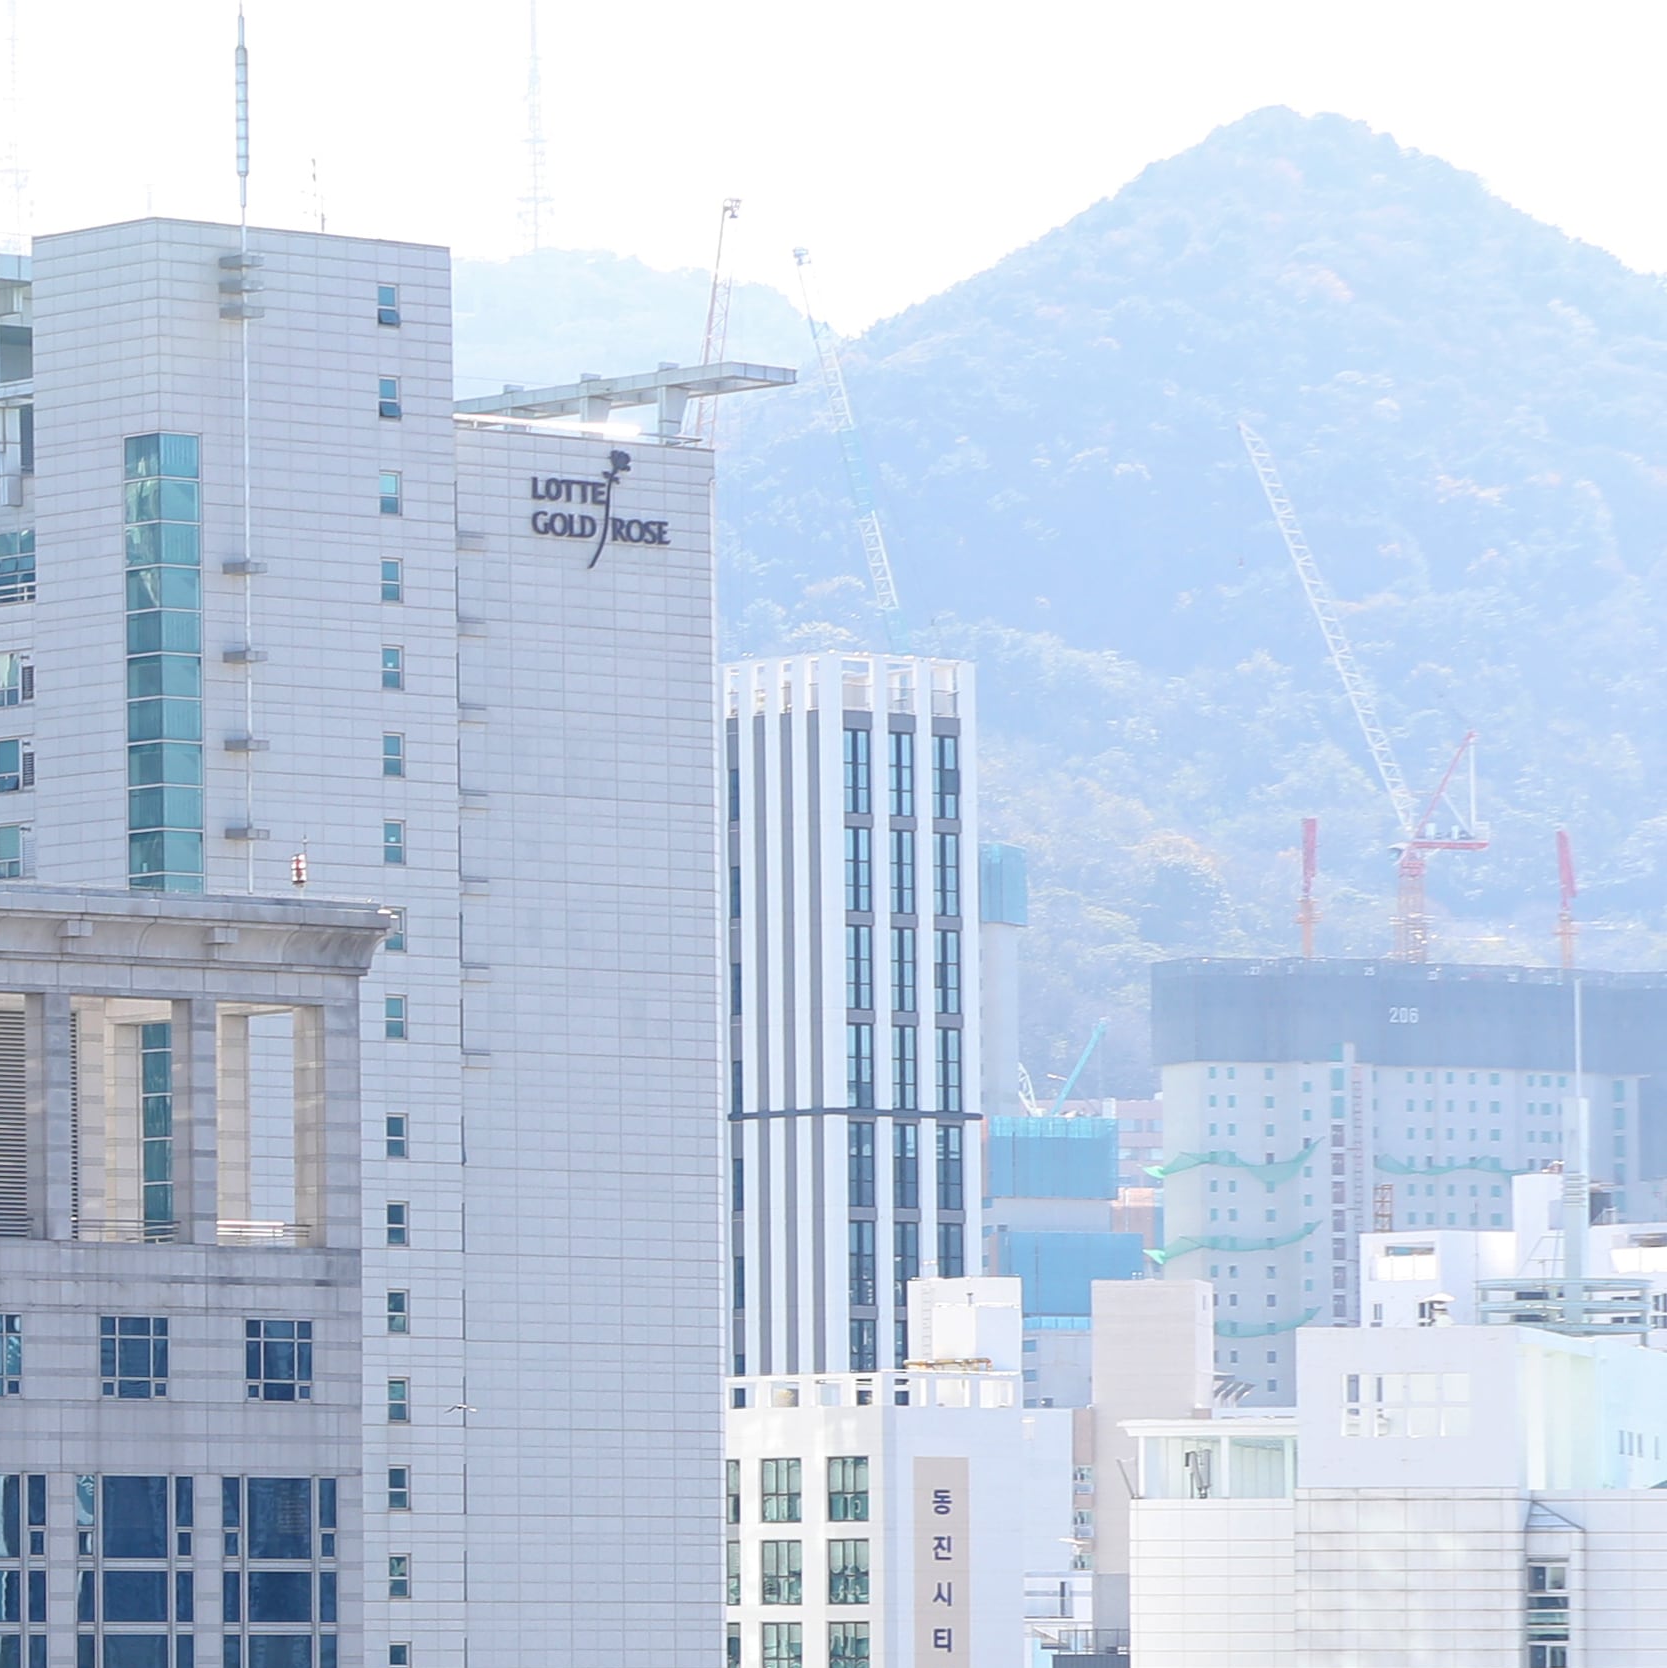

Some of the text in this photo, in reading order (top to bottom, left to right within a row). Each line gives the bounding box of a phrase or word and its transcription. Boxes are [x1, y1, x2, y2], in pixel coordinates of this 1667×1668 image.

[531, 477, 607, 505] LOTTE
[531, 511, 671, 545] GOLD ROSE
[1388, 1007, 1420, 1024] 206
